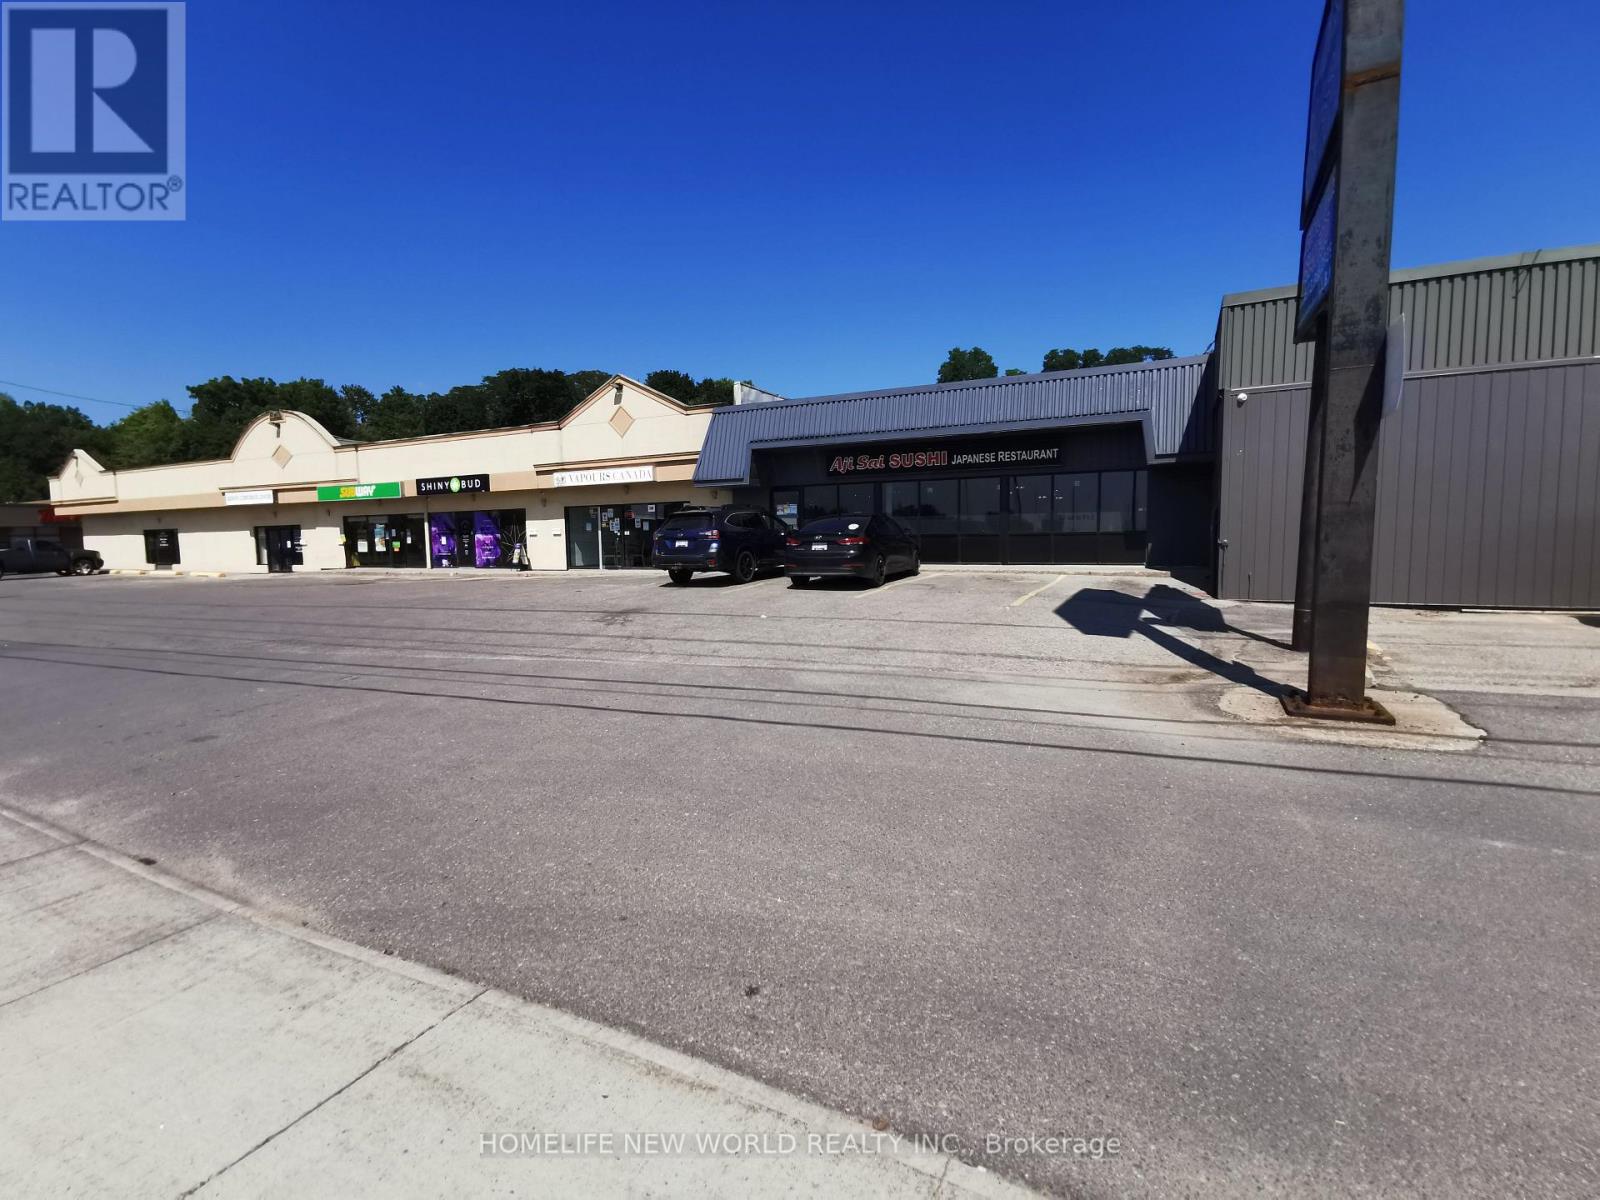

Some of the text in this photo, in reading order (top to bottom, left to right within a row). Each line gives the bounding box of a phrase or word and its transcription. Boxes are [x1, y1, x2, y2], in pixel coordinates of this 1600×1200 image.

[830, 448, 1059, 473] Aji Sai SUSHI JAPANESE RESTAURANT
[568, 472, 611, 483] VAPOURS
[612, 469, 652, 480] CANADA
[339, 485, 376, 498] SUBWAY
[421, 479, 480, 491] SHINY BUD
